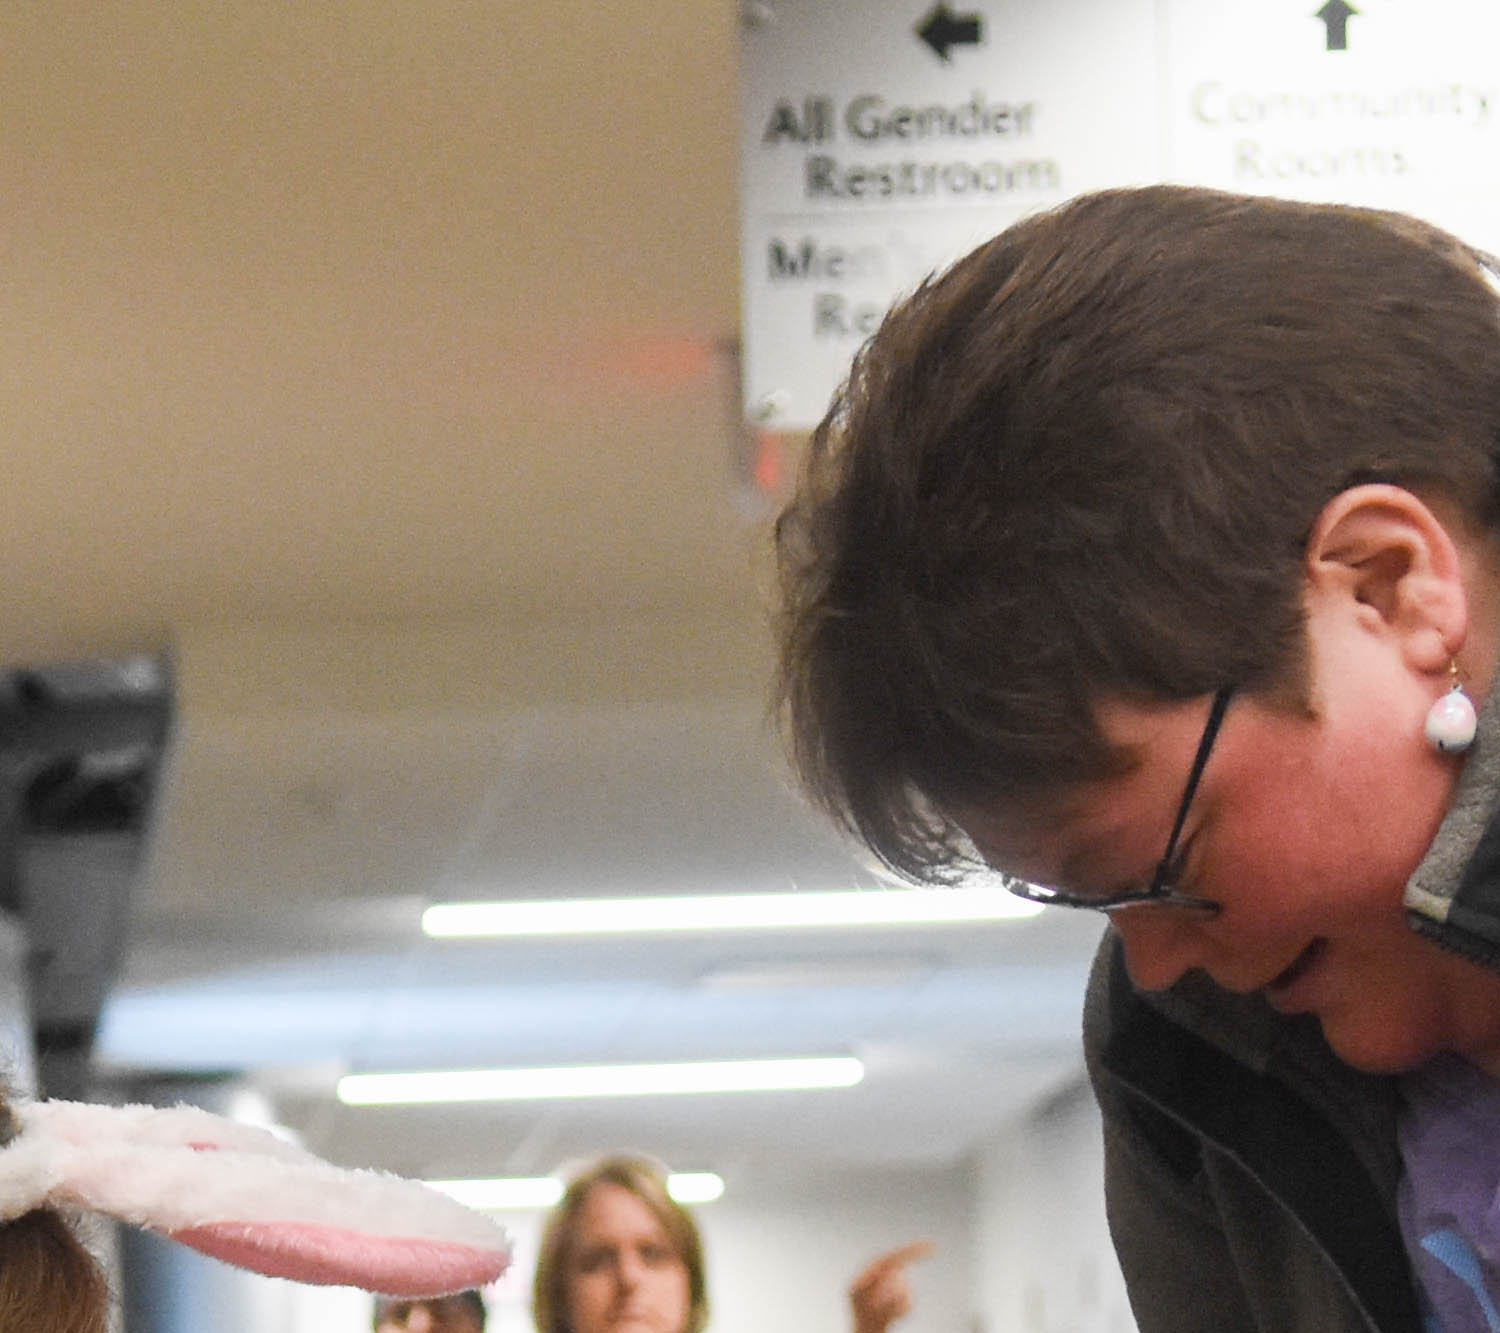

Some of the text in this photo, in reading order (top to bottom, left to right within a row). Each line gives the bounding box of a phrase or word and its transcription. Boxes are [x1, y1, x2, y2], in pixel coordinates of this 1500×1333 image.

[761, 91, 1037, 146] All Gender
[1190, 80, 1499, 131] Community
[805, 155, 1060, 199] Restroom
[1233, 138, 1408, 179] Rooms
